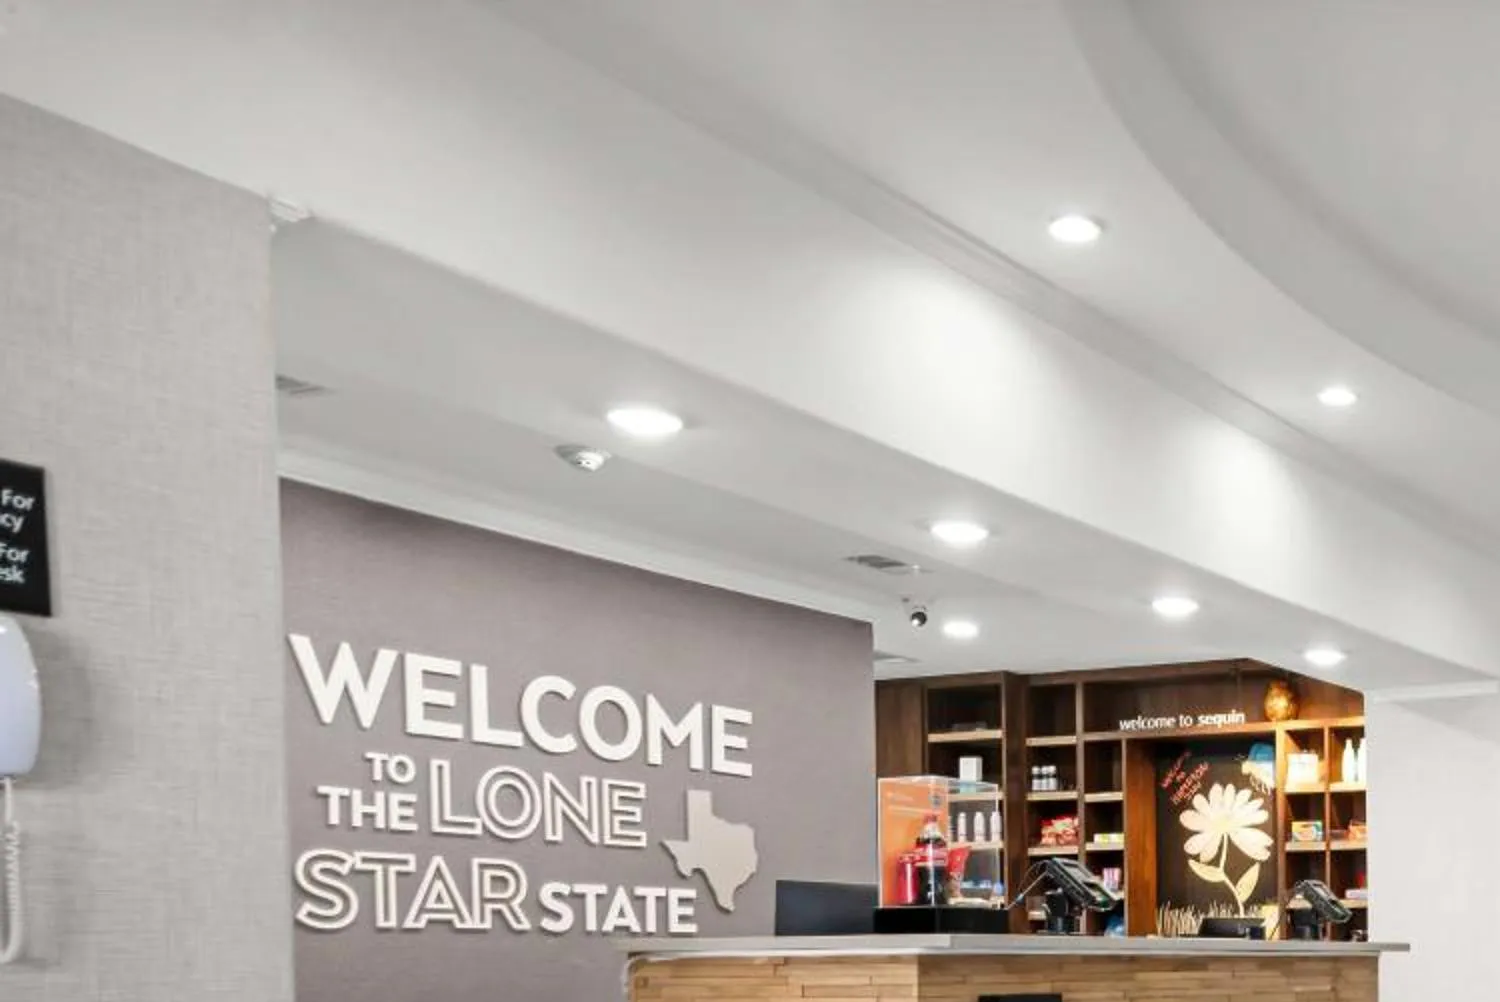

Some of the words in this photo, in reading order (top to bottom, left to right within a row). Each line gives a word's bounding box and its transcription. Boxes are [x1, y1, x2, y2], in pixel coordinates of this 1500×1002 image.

[1, 488, 35, 512] For
[0, 512, 25, 533] cy
[288, 632, 753, 778] WELCOME
[1119, 714, 1176, 731] welcome
[1179, 713, 1193, 728] to
[1197, 708, 1246, 729] sequin
[364, 751, 416, 784] TO
[316, 785, 418, 832] THE
[429, 758, 647, 848] LONE
[294, 848, 532, 931] STAR
[539, 881, 698, 935] STATE
